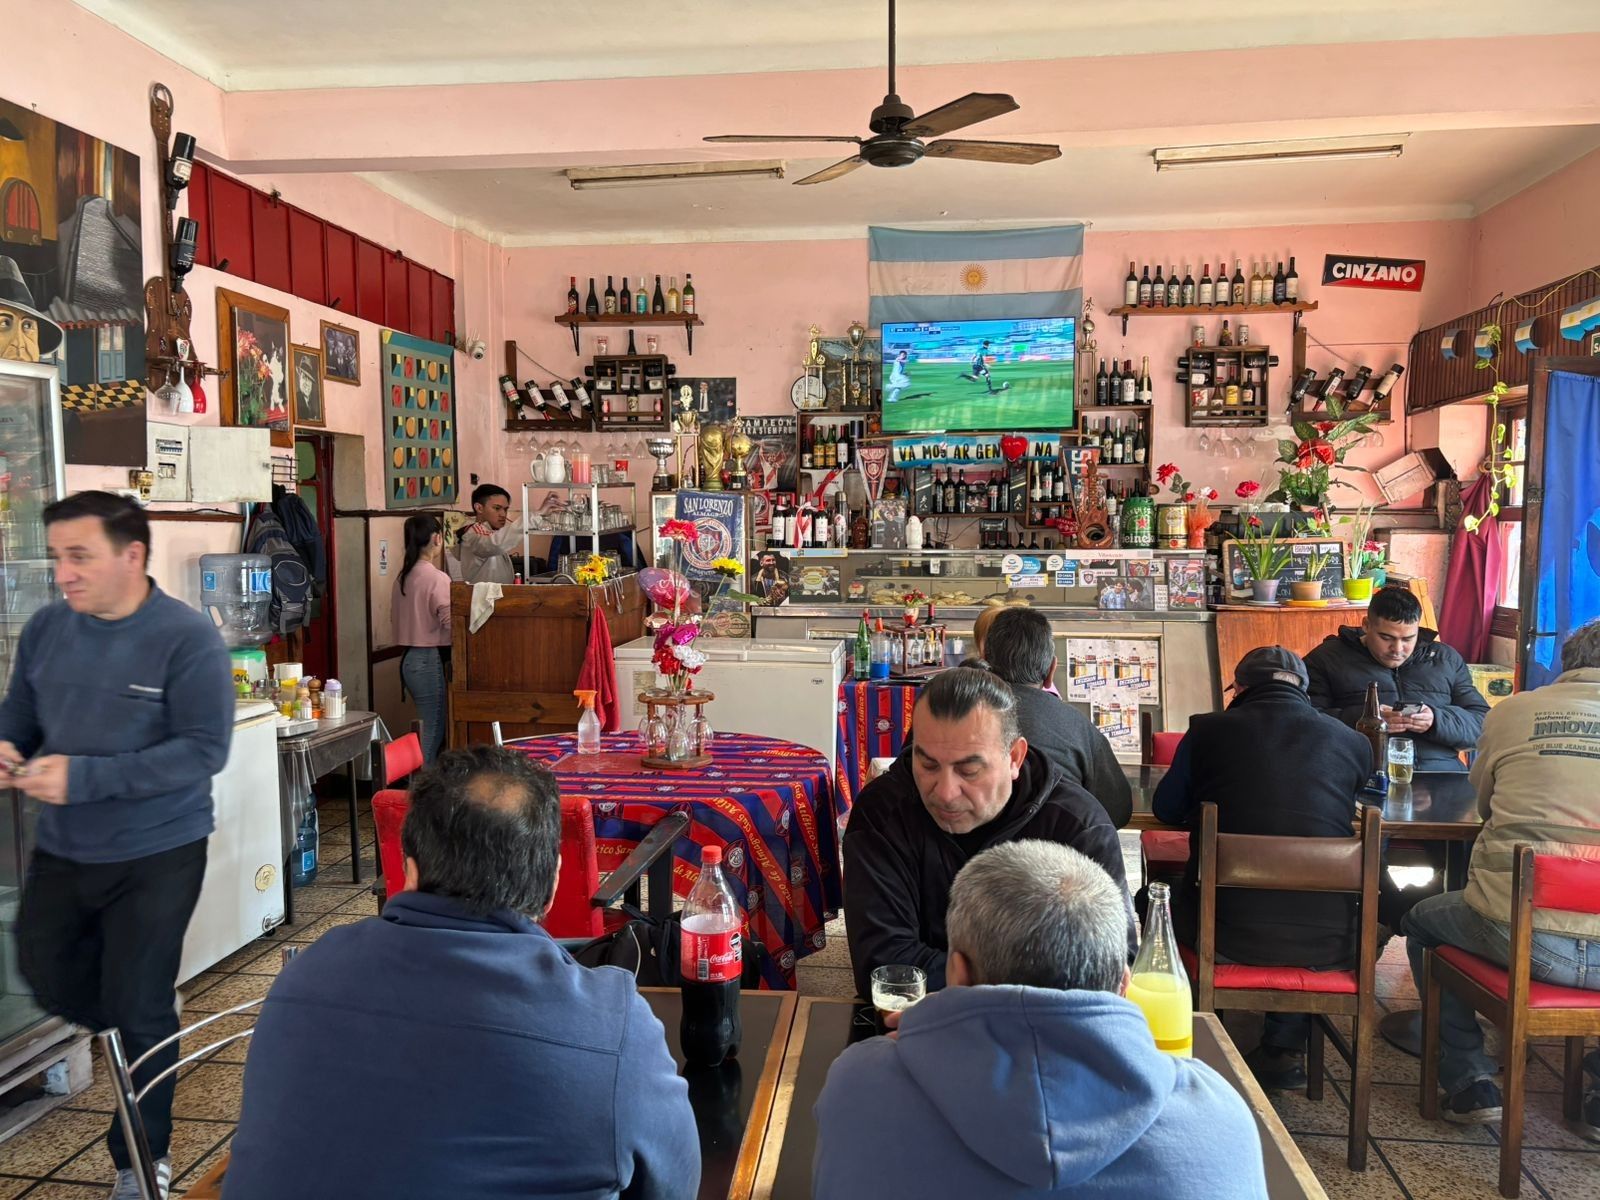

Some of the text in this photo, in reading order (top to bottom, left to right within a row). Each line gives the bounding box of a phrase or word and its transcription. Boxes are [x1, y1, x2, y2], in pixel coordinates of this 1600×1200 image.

[1332, 262, 1417, 283] CINZANO
[745, 417, 793, 427] AMPEÓN
[741, 426, 793, 435] ARA SIEMPRE
[683, 497, 734, 517] SAN LORENZO
[1532, 743, 1544, 751] THE
